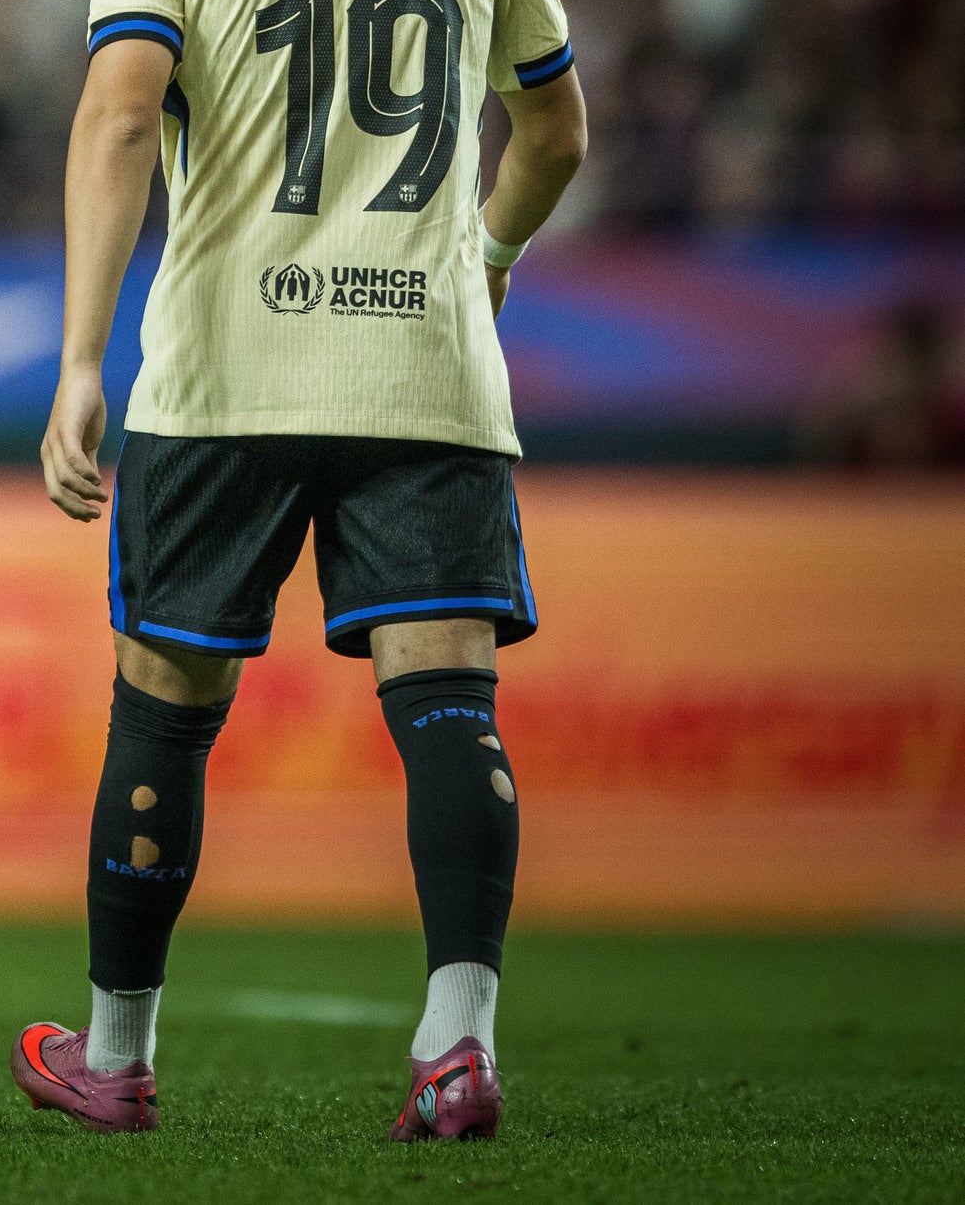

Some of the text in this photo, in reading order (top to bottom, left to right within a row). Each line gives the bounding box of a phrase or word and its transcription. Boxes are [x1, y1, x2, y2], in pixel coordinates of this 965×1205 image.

[331, 267, 427, 290] UNHCR
[329, 288, 426, 311] ACNUR
[330, 308, 425, 321] The UN Refugee Agency
